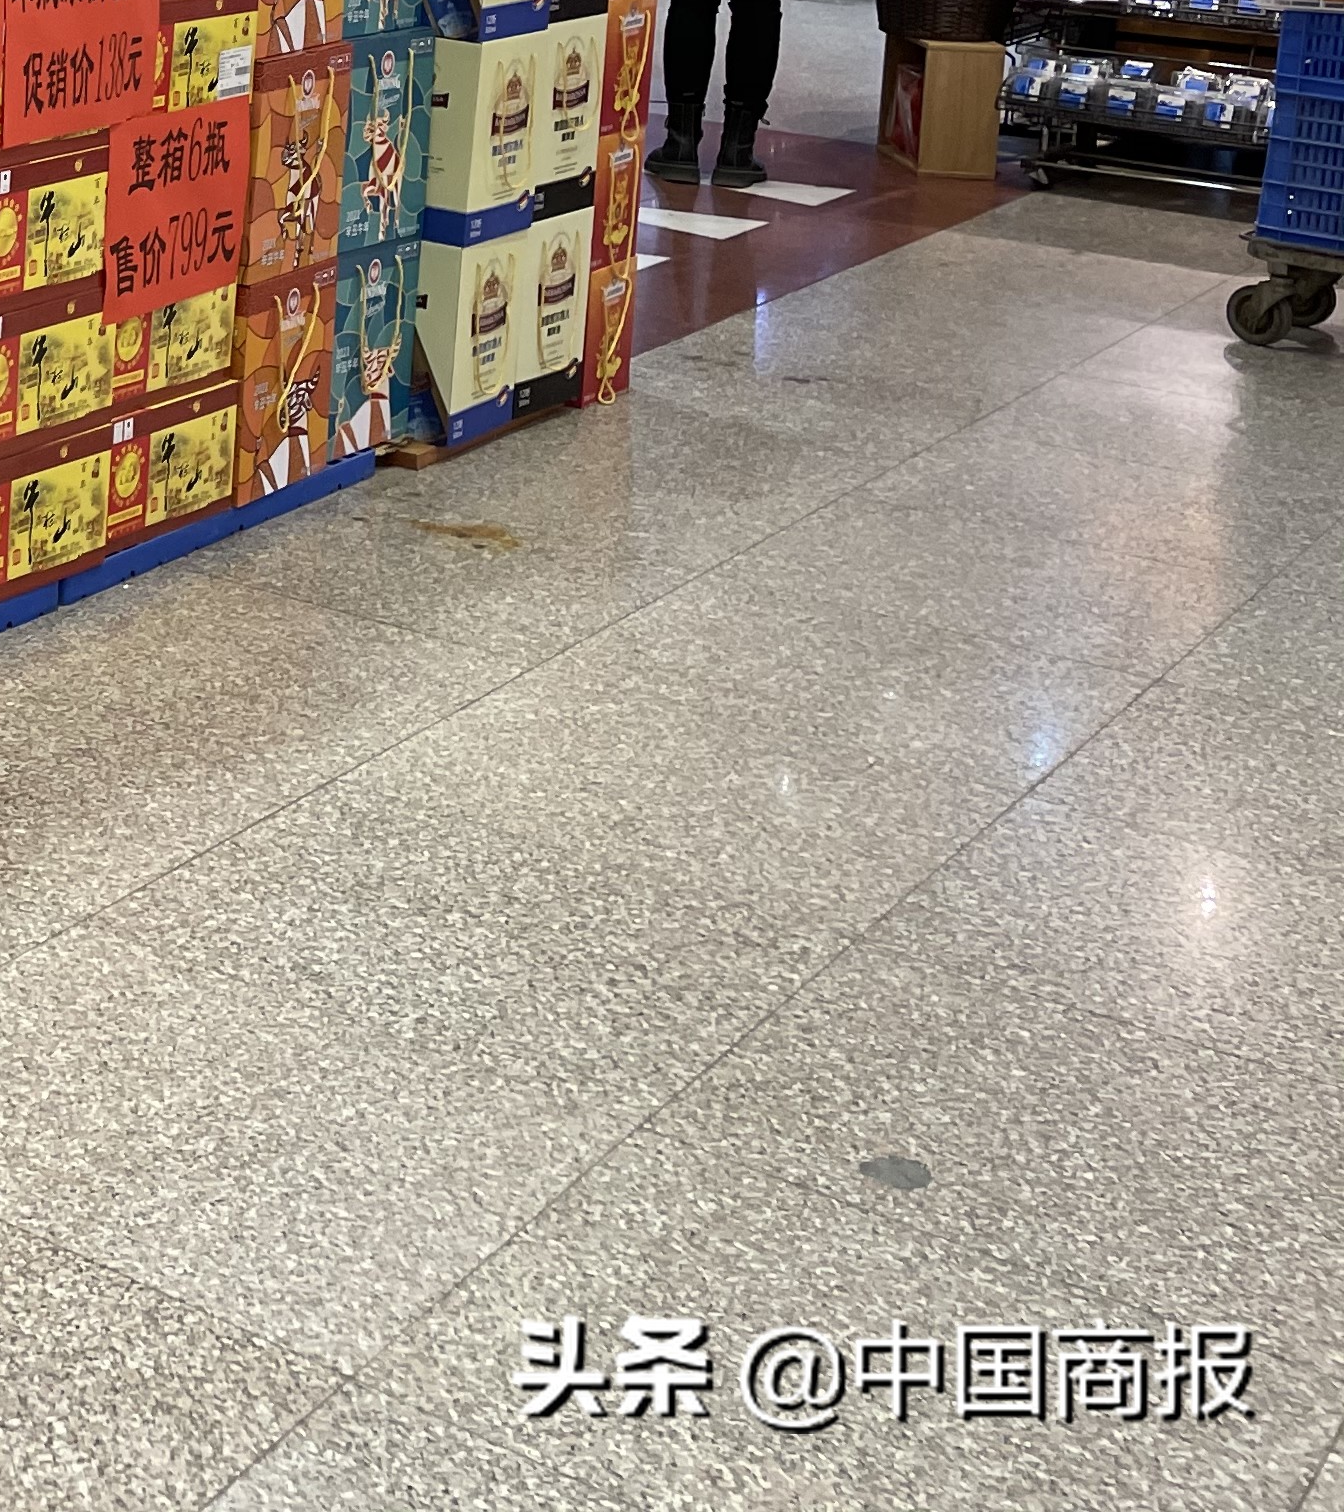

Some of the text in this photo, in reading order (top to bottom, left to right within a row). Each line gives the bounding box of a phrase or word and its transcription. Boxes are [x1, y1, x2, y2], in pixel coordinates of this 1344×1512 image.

[23, 31, 143, 119] 促销价138元
[127, 117, 231, 197] 整箱6瓶
[109, 209, 237, 297] 售价799元
